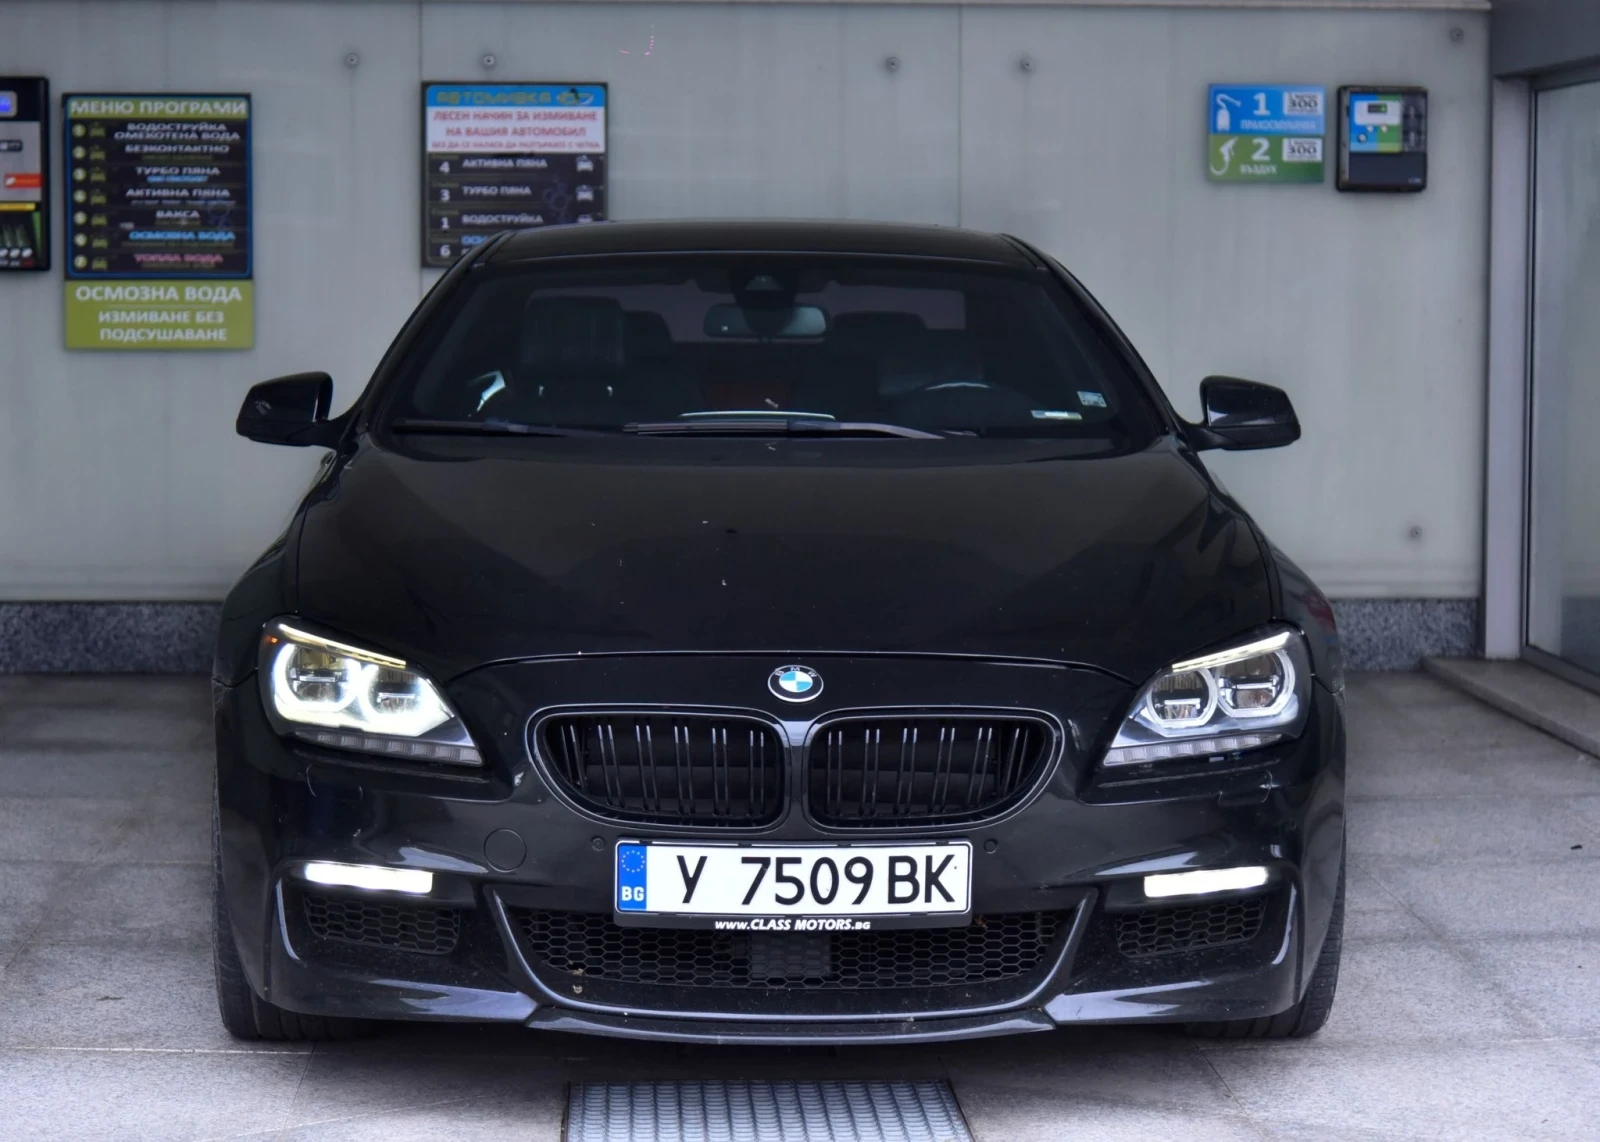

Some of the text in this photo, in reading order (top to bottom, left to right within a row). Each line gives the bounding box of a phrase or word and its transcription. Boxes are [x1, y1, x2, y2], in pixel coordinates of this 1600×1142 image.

[71, 101, 246, 114] МЕНЮ ПРОГРАМИ
[1252, 92, 1271, 116] 1
[1288, 98, 1318, 108] 300
[434, 111, 598, 120] ЛЕСЕН НАЧИН ЗА ИЗМИВАНЕ
[127, 122, 227, 132] ВОДОСТРУЙКА
[446, 127, 586, 137] НА ВАШИЯ АВТОМОБИЛ
[114, 132, 240, 141] ОМЕКОТЕНА ВОДА
[125, 144, 230, 153] БЕЗКОНТАКТНО
[1252, 137, 1270, 161] 2
[1288, 144, 1317, 154] 300
[439, 161, 450, 174] 4
[462, 158, 514, 168] АКТИВНА
[516, 158, 548, 168] ПЯНА
[136, 166, 220, 176] ТУРБО ПЯНА
[126, 188, 230, 198] АКТИВНА ПЯНА
[440, 189, 450, 202] 3
[462, 186, 532, 196] ТУРБО ПЯНА
[156, 210, 200, 218] ВАКСА
[461, 212, 544, 225] ВОДОСТРУЙКА
[440, 217, 450, 230] 1
[440, 245, 450, 258] 6
[76, 286, 242, 304] ОСМОЗНА ВОДА
[98, 311, 224, 324] ИЗМИВАНЕ БЕЗ
[100, 328, 228, 342] ПОДСУШАВАНЕ
[774, 666, 818, 678] BMW
[740, 856, 874, 906] 7509
[888, 854, 956, 905] BK
[622, 886, 645, 902] BG
[715, 919, 871, 931] www.CLASS MOTORS.BG
